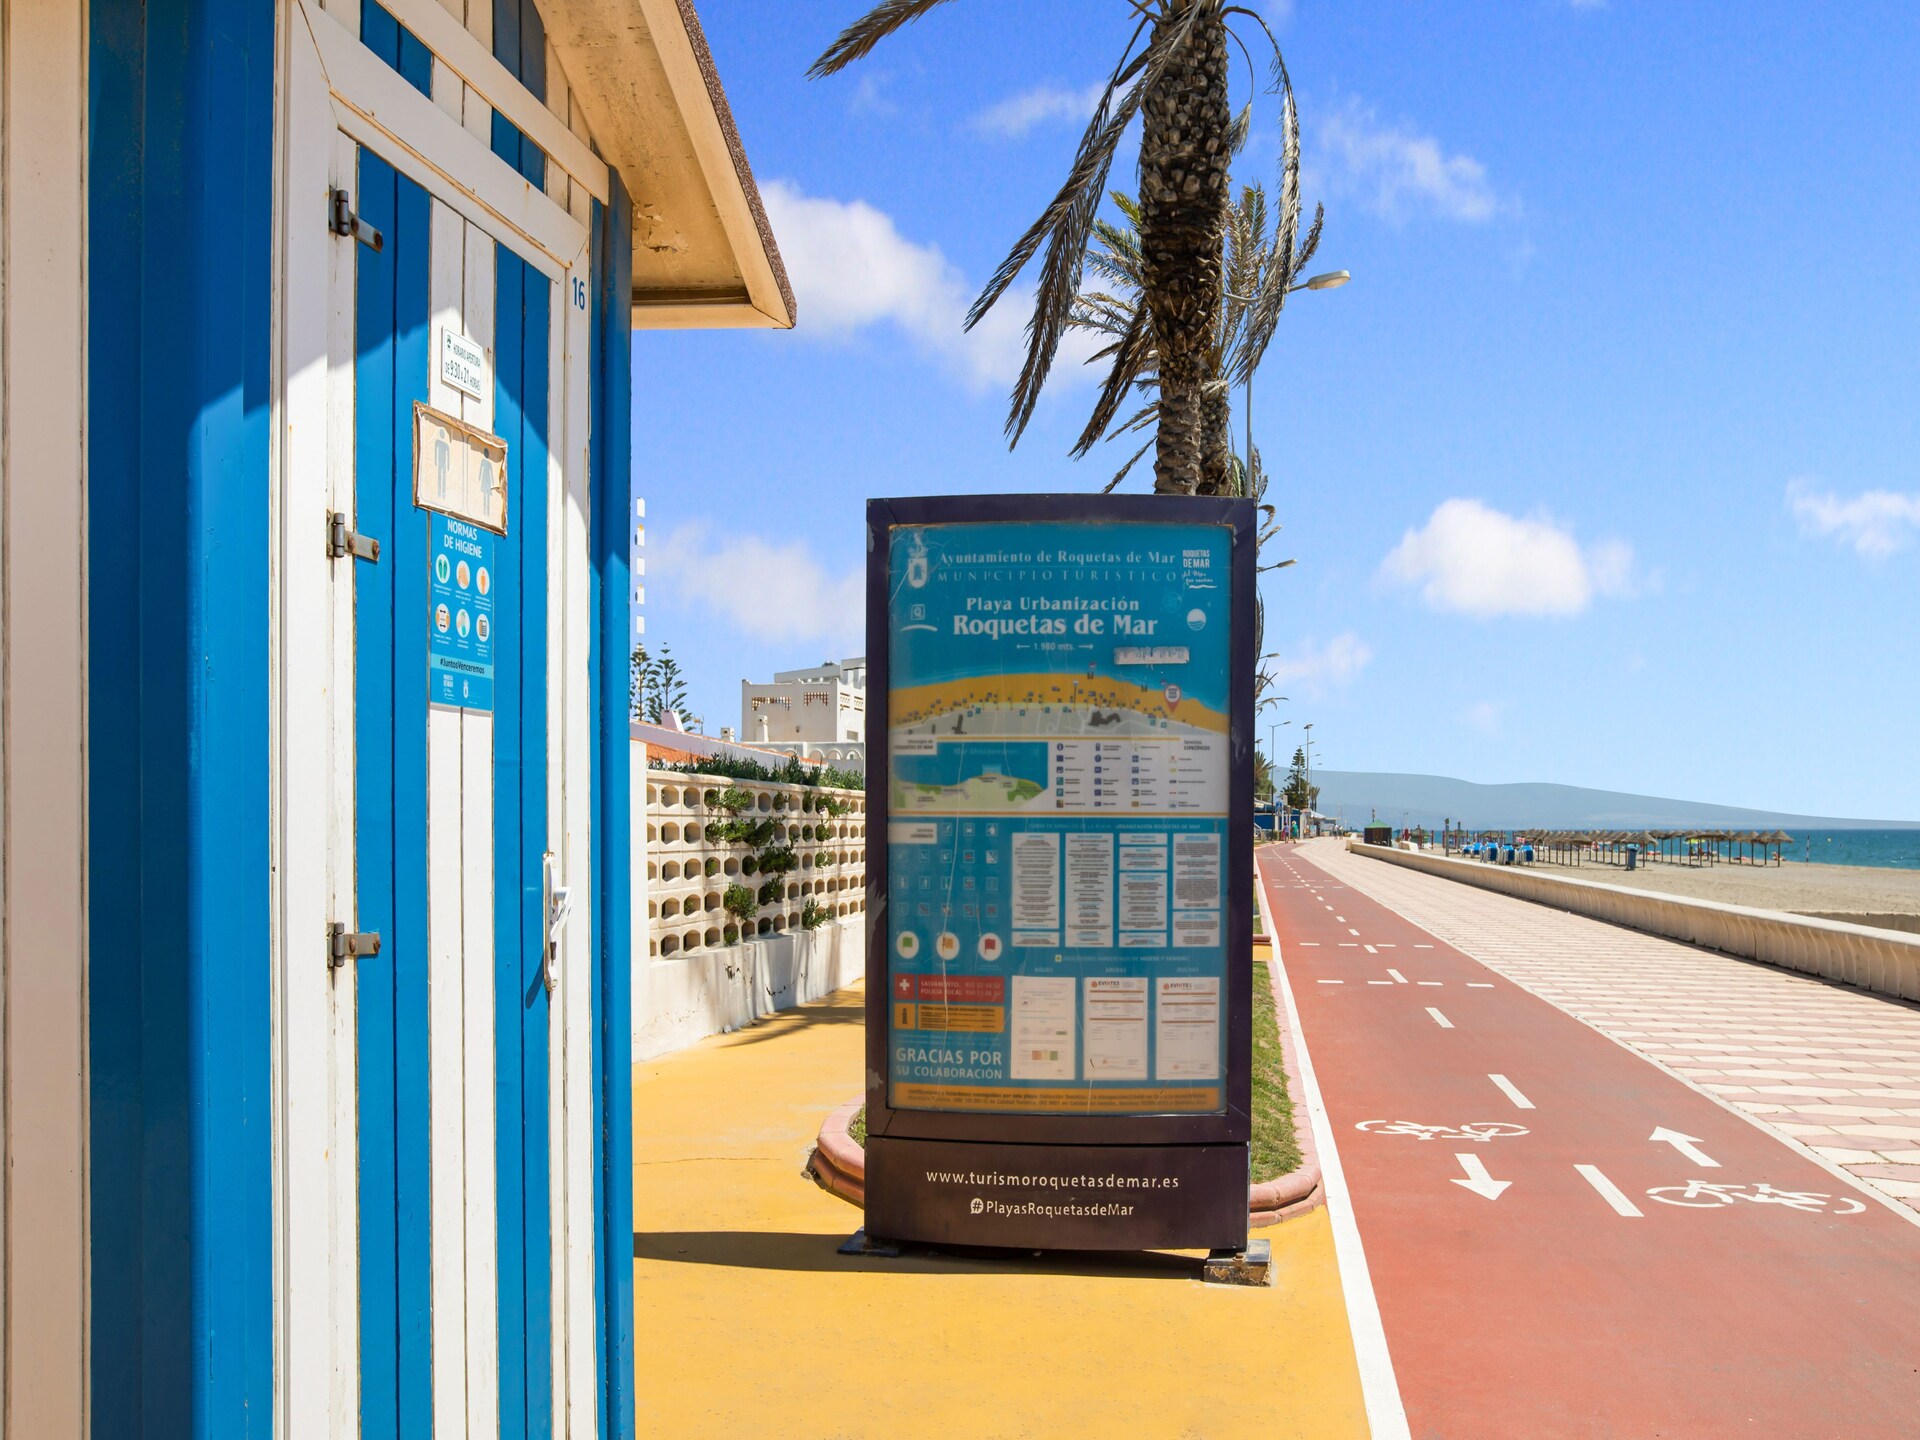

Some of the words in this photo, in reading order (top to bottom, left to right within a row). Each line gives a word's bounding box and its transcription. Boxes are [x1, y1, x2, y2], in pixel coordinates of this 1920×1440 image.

[573, 277, 585, 310] 16
[463, 367, 469, 384] 21
[447, 519, 477, 541] NORMAS
[444, 535, 454, 549] DE
[455, 538, 482, 558] HIGIENE
[1182, 550, 1210, 558] ROQUETAS
[940, 551, 1032, 566] Ayuntamiento
[1037, 550, 1052, 562] de
[1058, 551, 1121, 565] Roquetas
[1126, 551, 1142, 563] de
[1148, 551, 1176, 563] Mar
[1183, 558, 1193, 568] DE
[1193, 558, 1210, 568] MAR
[938, 570, 1052, 582] MUNICIPIO
[1063, 569, 1176, 581] TURISTICO
[966, 597, 1012, 614] Playa
[1020, 596, 1140, 611] Urbanización
[953, 614, 1067, 640] Roquetas
[1074, 613, 1104, 635] de
[1113, 614, 1158, 635] Mar
[440, 658, 485, 675] #JuntosVenceremos
[895, 1048, 963, 1064] GRACIAS
[970, 1051, 1002, 1066] POR
[895, 1066, 910, 1076] SU
[914, 1066, 1002, 1079] COLABORACIÓN
[926, 1171, 1179, 1190] www.turismoroquetasdemar.es
